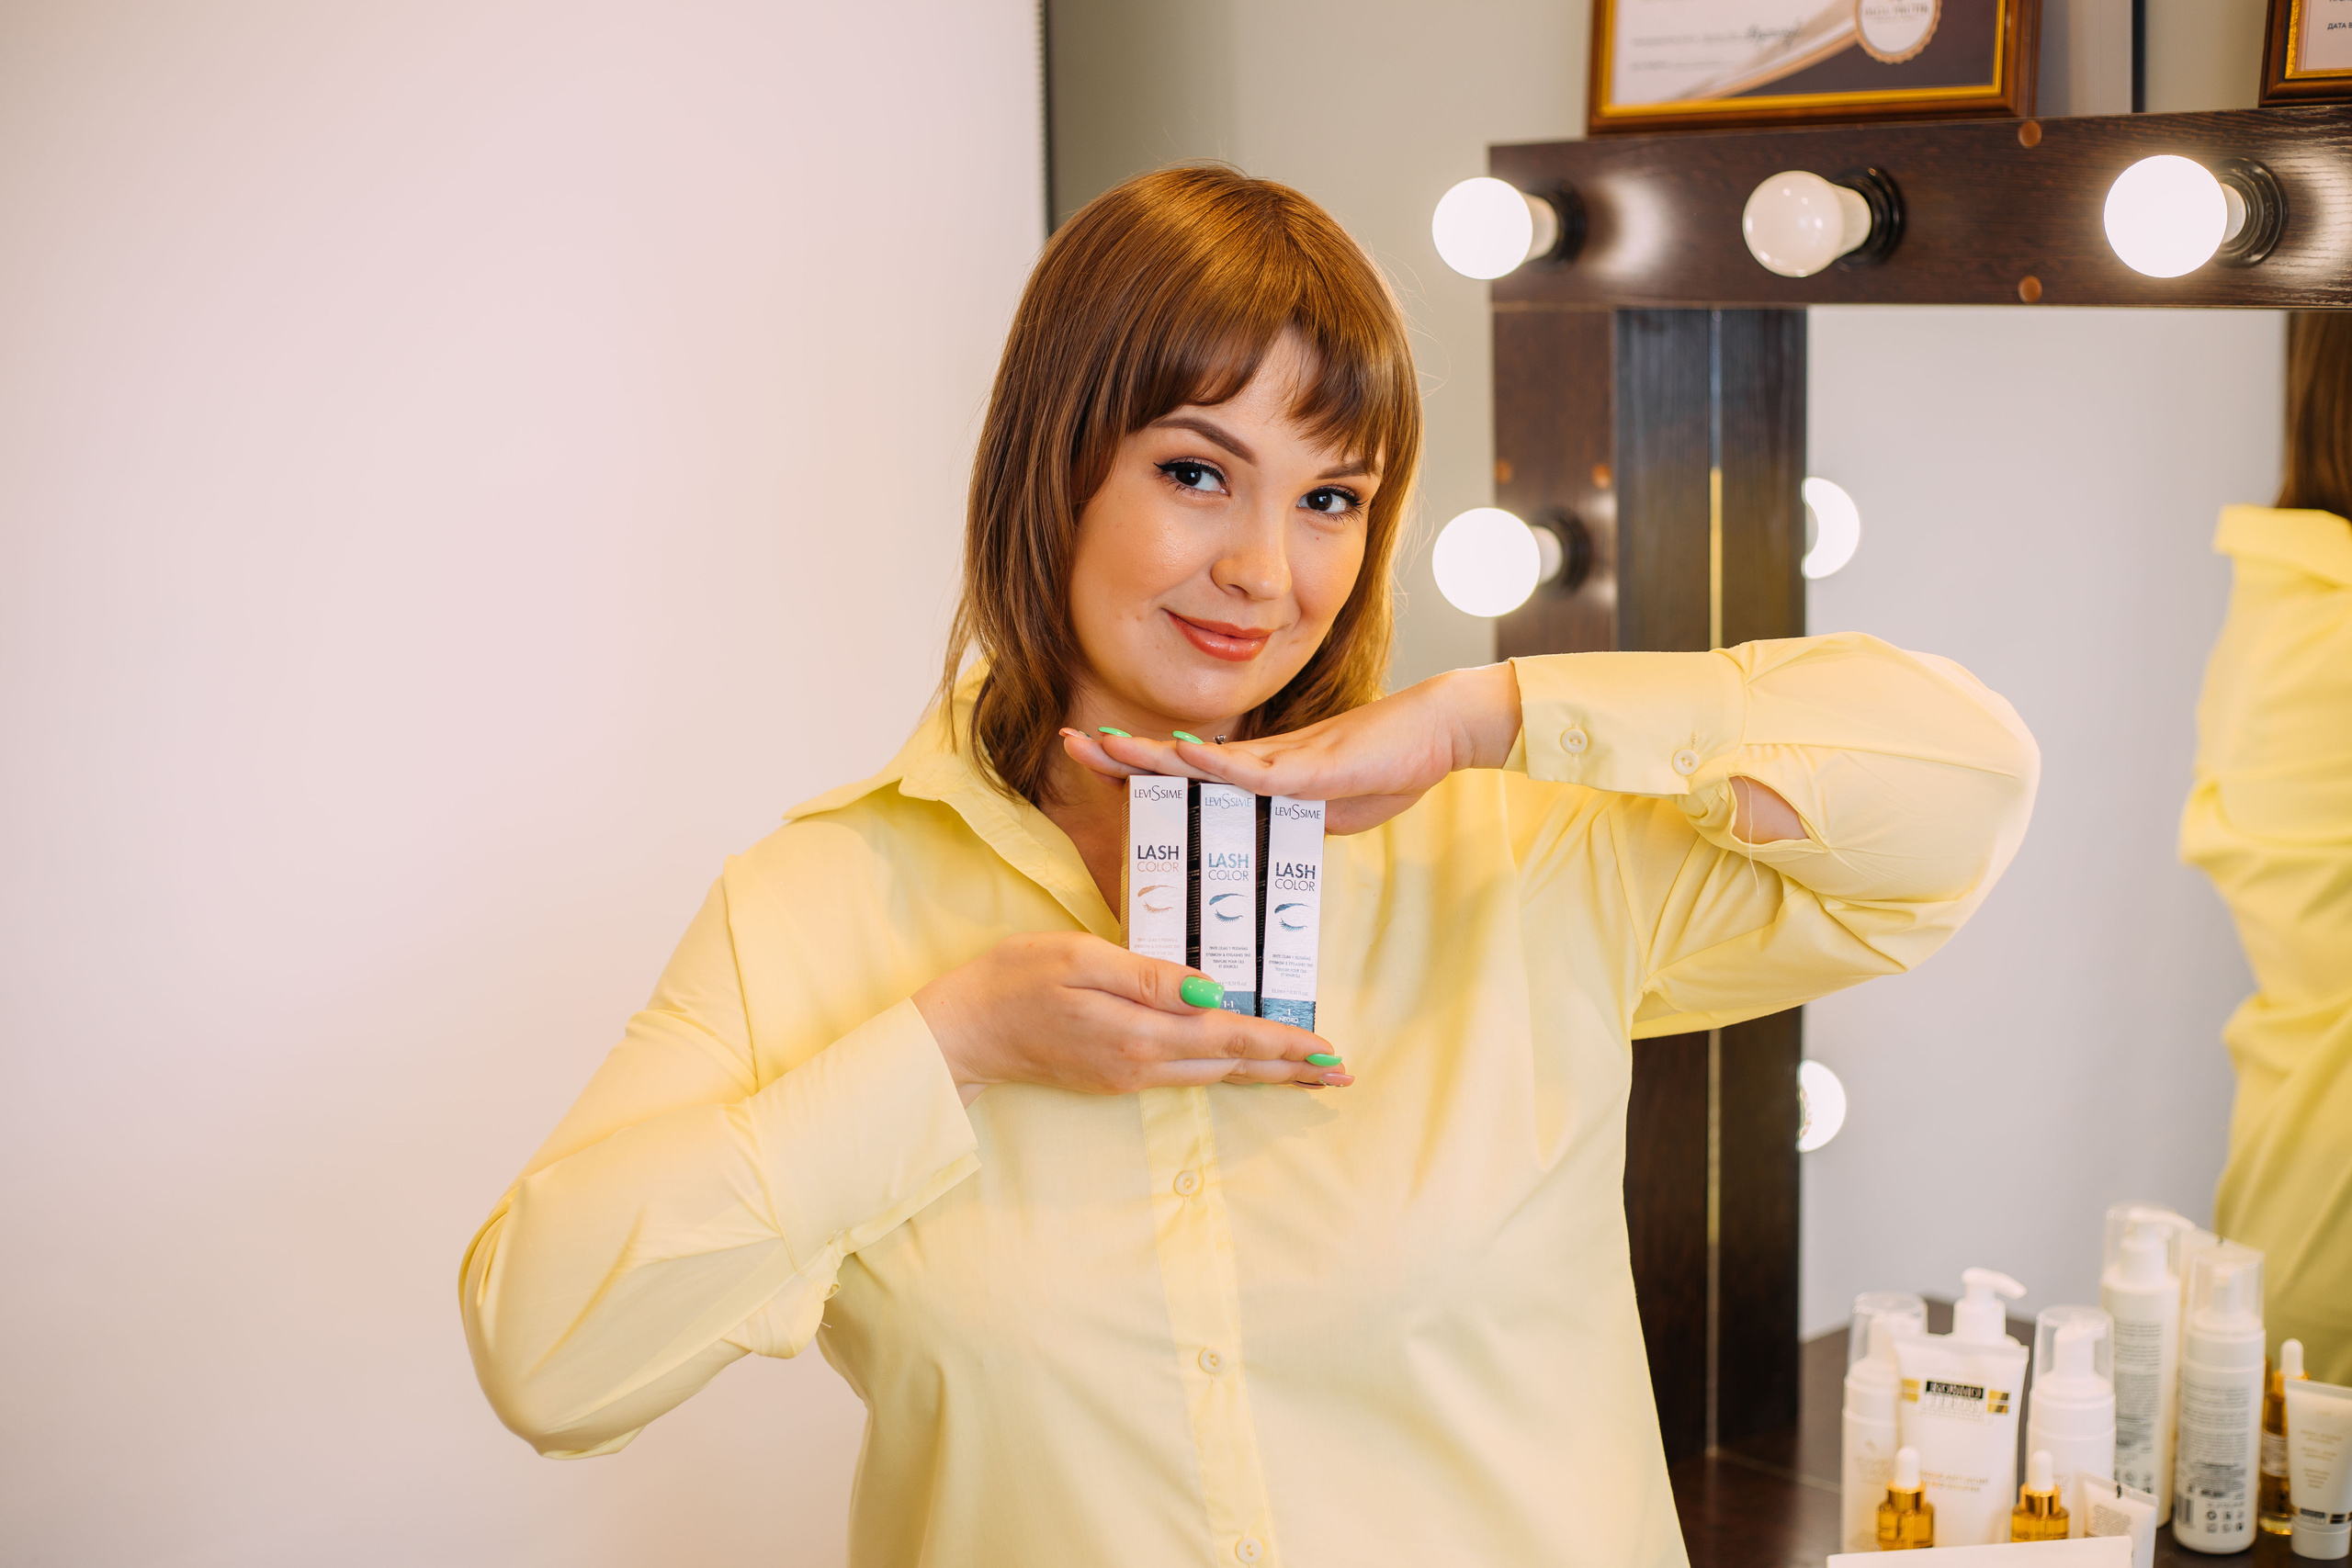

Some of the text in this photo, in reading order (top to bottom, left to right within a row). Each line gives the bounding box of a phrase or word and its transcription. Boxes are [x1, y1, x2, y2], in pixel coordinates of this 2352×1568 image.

[1134, 785, 1182, 801] LEVISSIME
[1205, 793, 1252, 809] LEVISSIME
[1275, 804, 1321, 820] LEVISSIME
[1137, 845, 1179, 860] LASH
[1208, 852, 1249, 868] LASH
[1136, 862, 1179, 873] COLOR
[1276, 862, 1316, 879] LASH
[1208, 870, 1249, 881] COLOR
[1275, 878, 1316, 892] COLOR
[1223, 1000, 1234, 1009] 1-1
